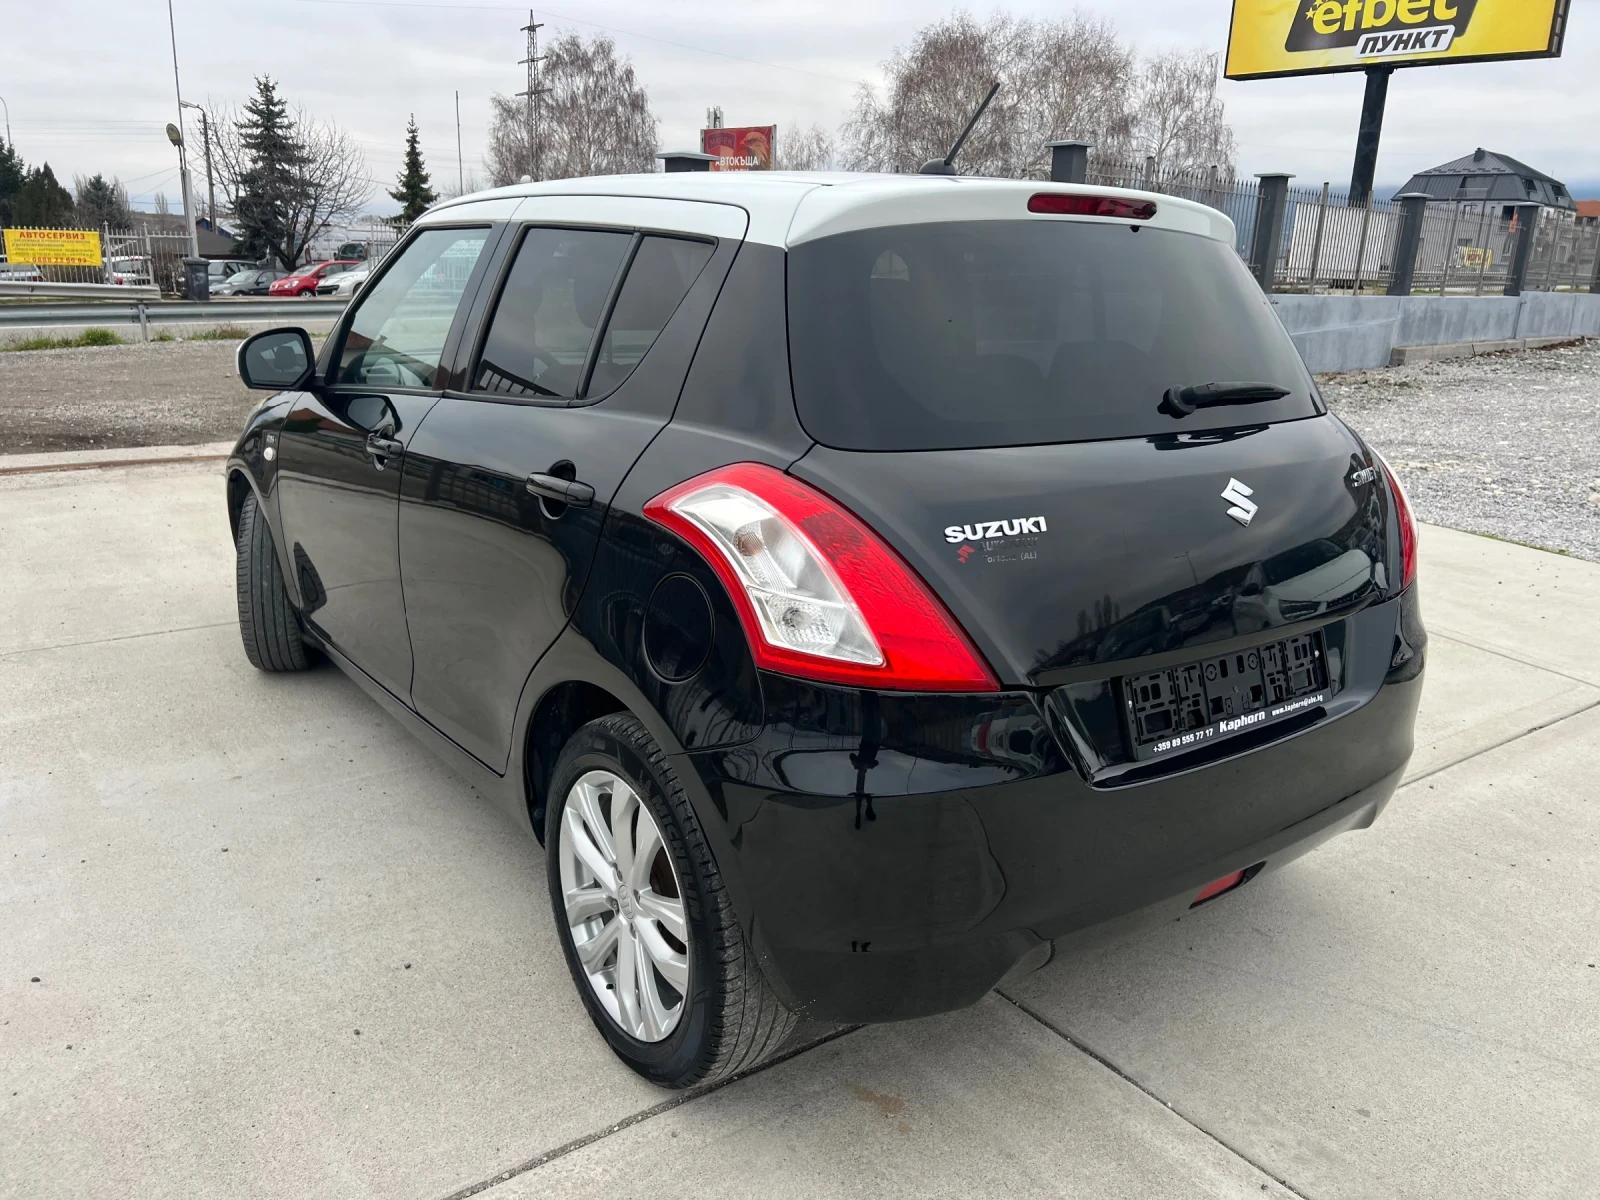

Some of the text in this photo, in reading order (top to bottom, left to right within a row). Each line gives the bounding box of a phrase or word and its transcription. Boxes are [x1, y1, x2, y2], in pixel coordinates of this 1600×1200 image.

[1359, 29, 1449, 54] ПУНКТ
[19, 231, 86, 240] АВТОСЕРВИЗ
[944, 516, 1047, 542] SUZUKI
[1153, 740, 1171, 753] +359
[1171, 737, 1181, 748] 89
[1181, 733, 1195, 745] 555
[1195, 730, 1205, 741] 77
[1205, 727, 1214, 738] 17
[1219, 710, 1266, 733] Kaphorn
[650, 793, 704, 926] MICHELIN
